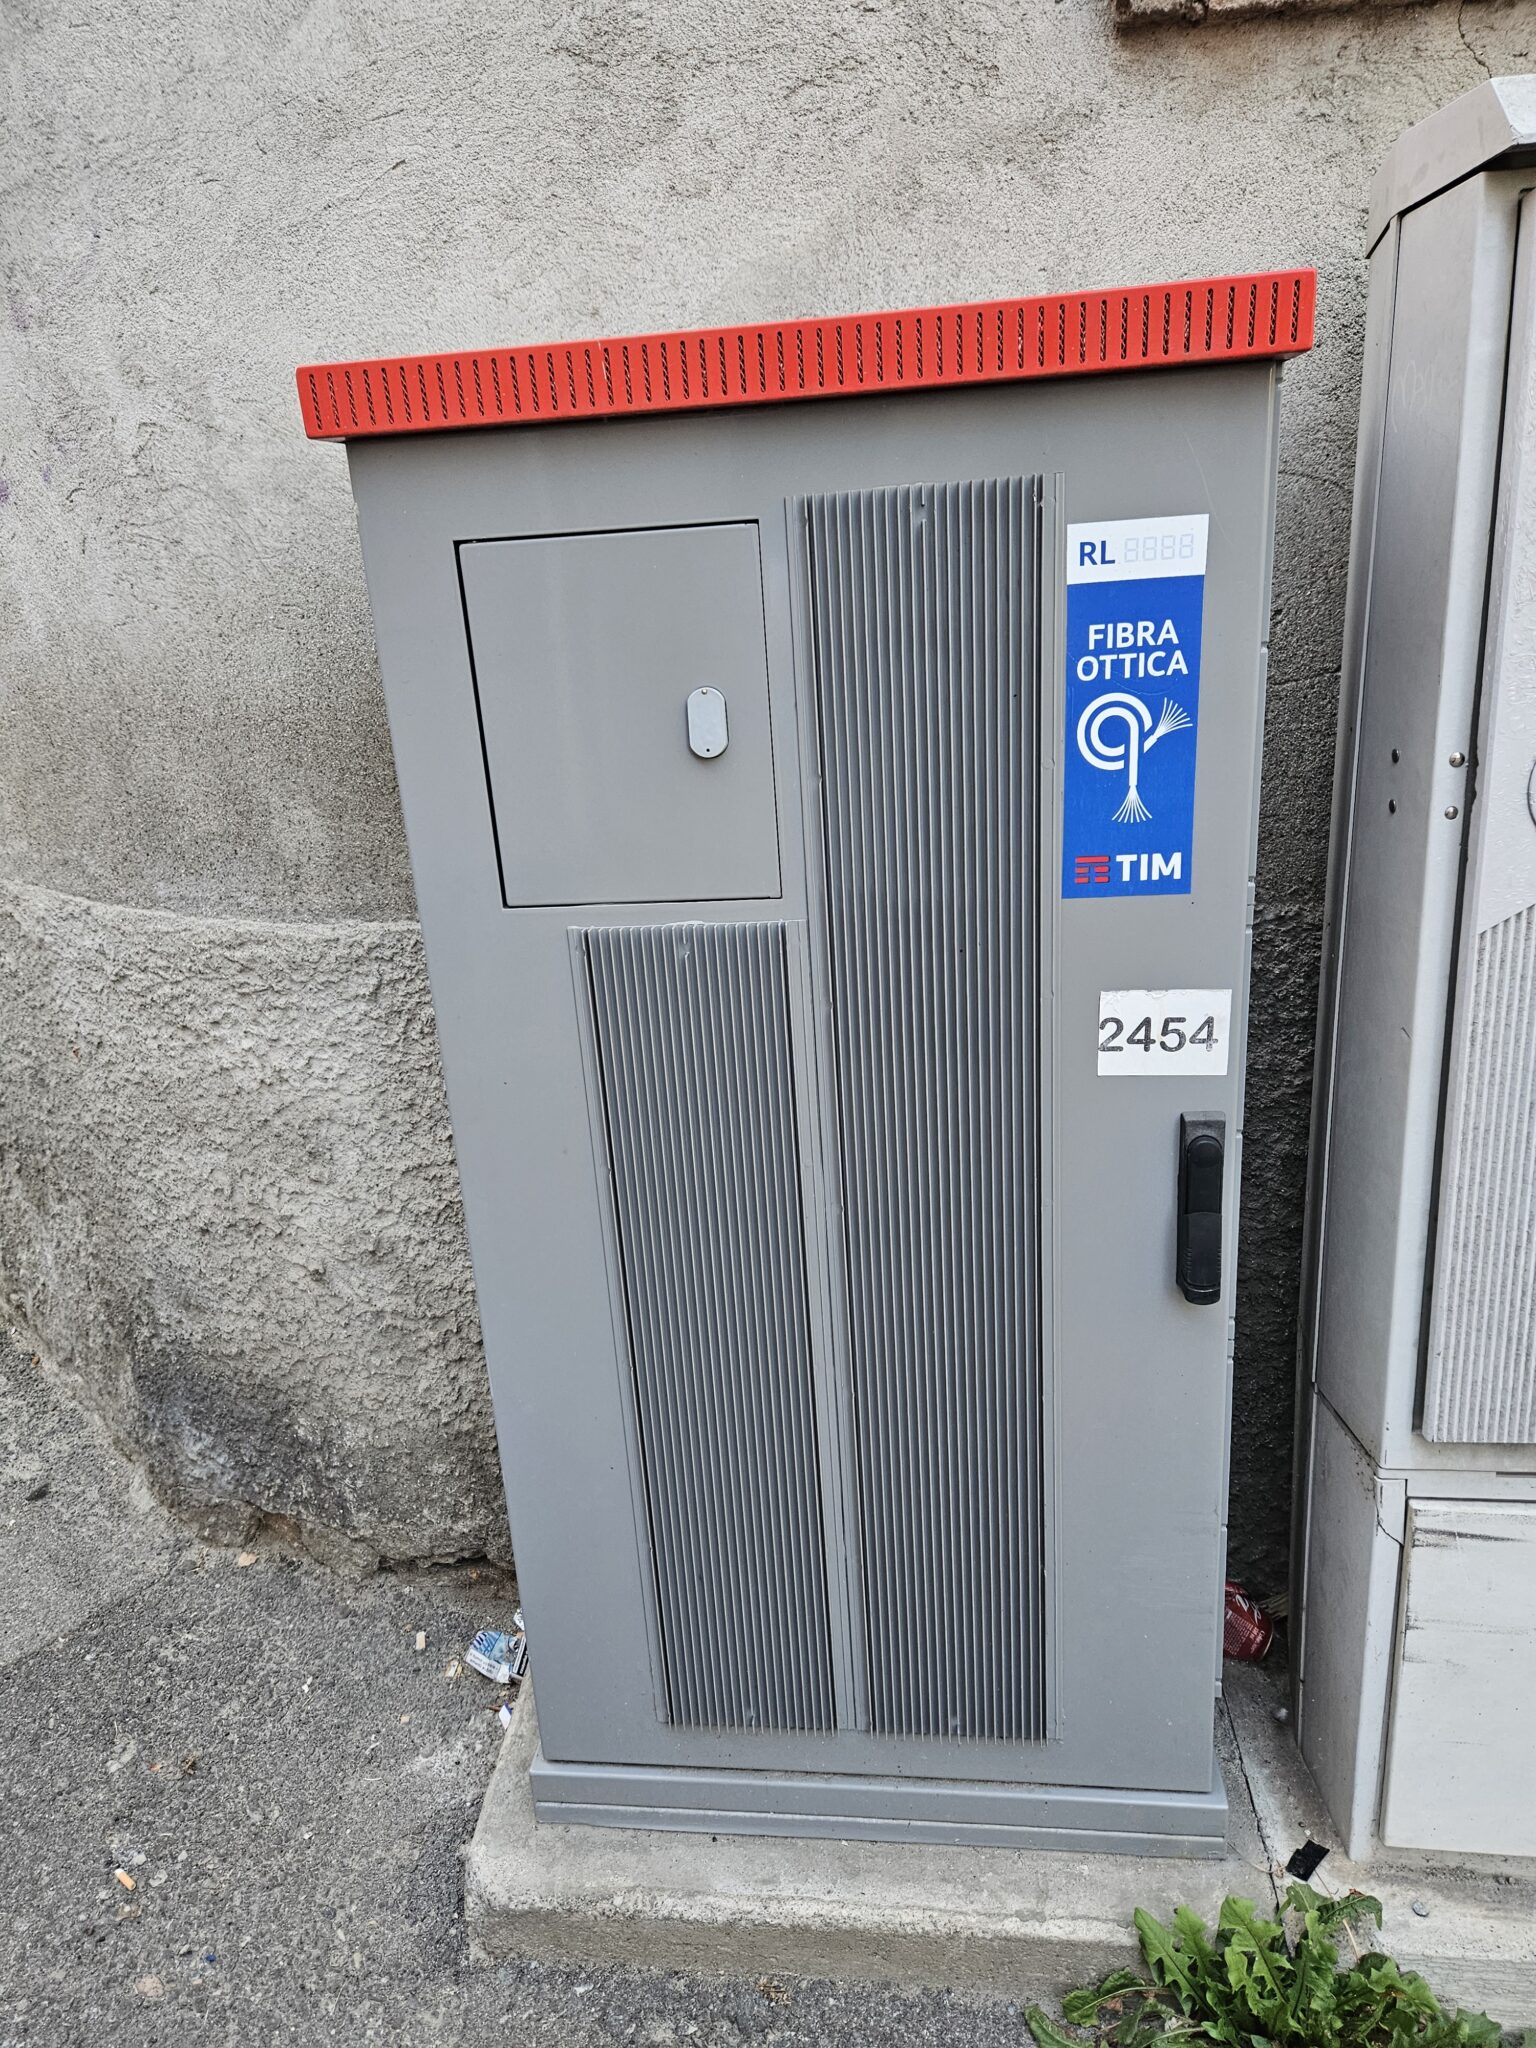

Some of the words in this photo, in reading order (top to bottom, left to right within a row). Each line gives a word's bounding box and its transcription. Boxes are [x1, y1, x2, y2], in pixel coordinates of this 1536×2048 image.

[1080, 540, 1116, 566] RL
[1088, 619, 1179, 650] FIBRA
[1076, 649, 1189, 682] OTTICA
[1115, 852, 1182, 882] TIM
[1098, 1016, 1219, 1052] 2454
